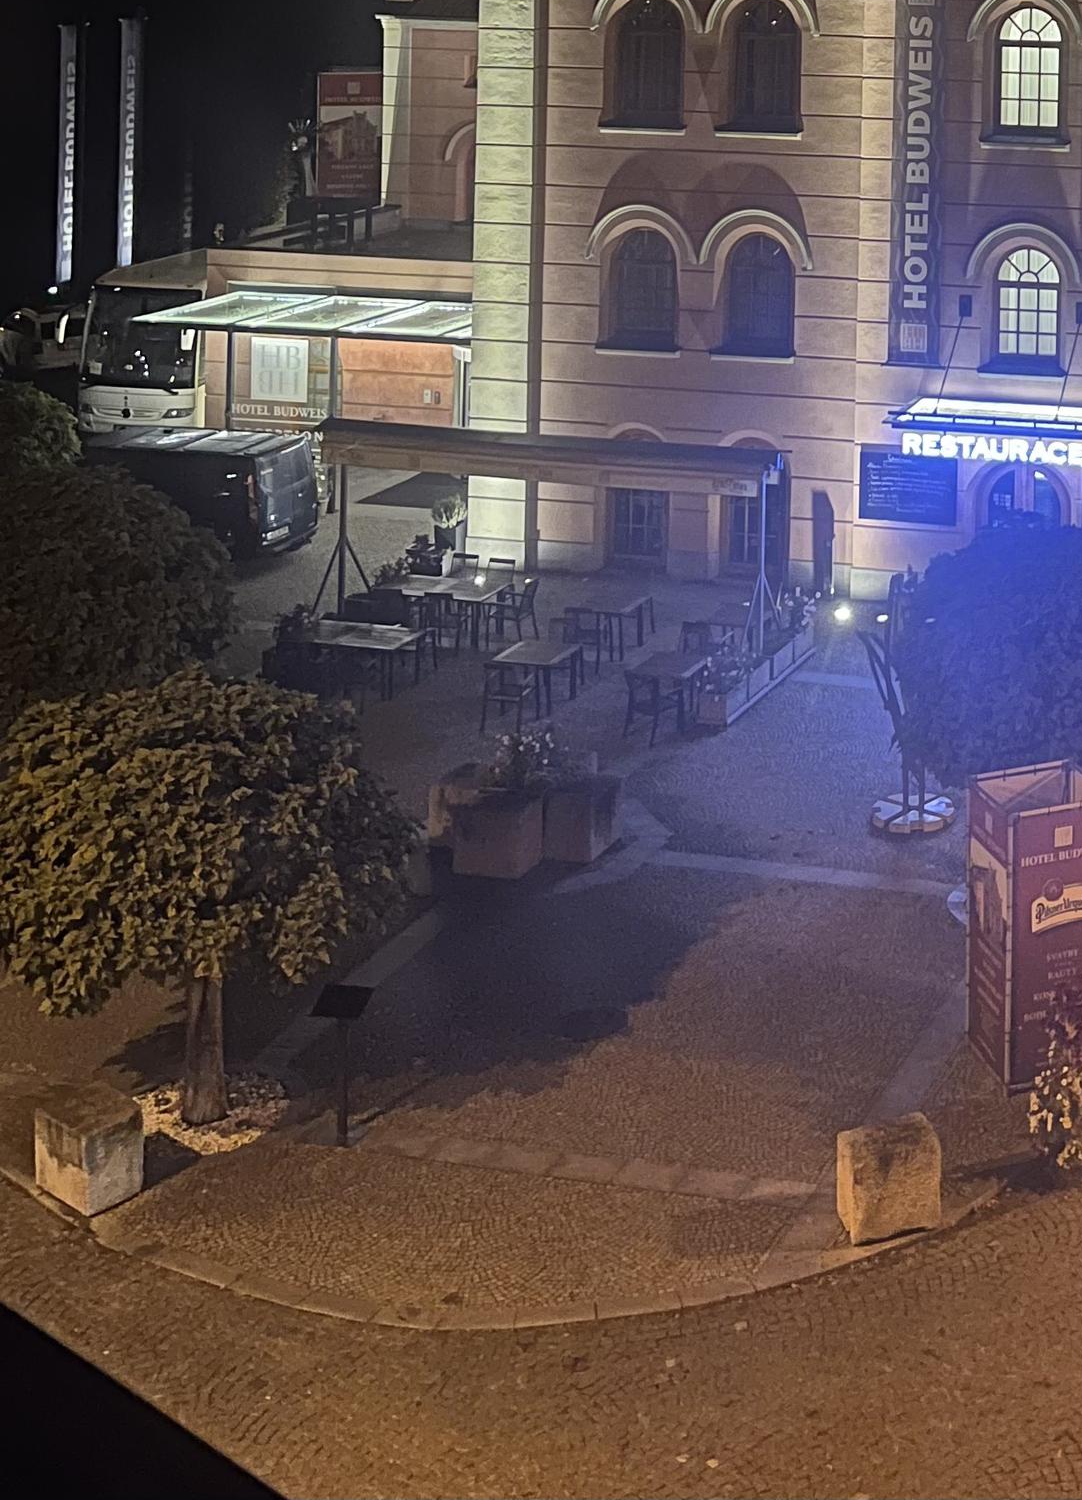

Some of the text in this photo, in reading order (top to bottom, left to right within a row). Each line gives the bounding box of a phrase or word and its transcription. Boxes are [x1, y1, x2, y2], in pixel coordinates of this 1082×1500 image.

[905, 15, 934, 184] BUDWEIS
[903, 192, 930, 309] HOTEL
[231, 403, 327, 419] HOTEL BUDWEIS
[1021, 852, 1057, 868] HOTEL
